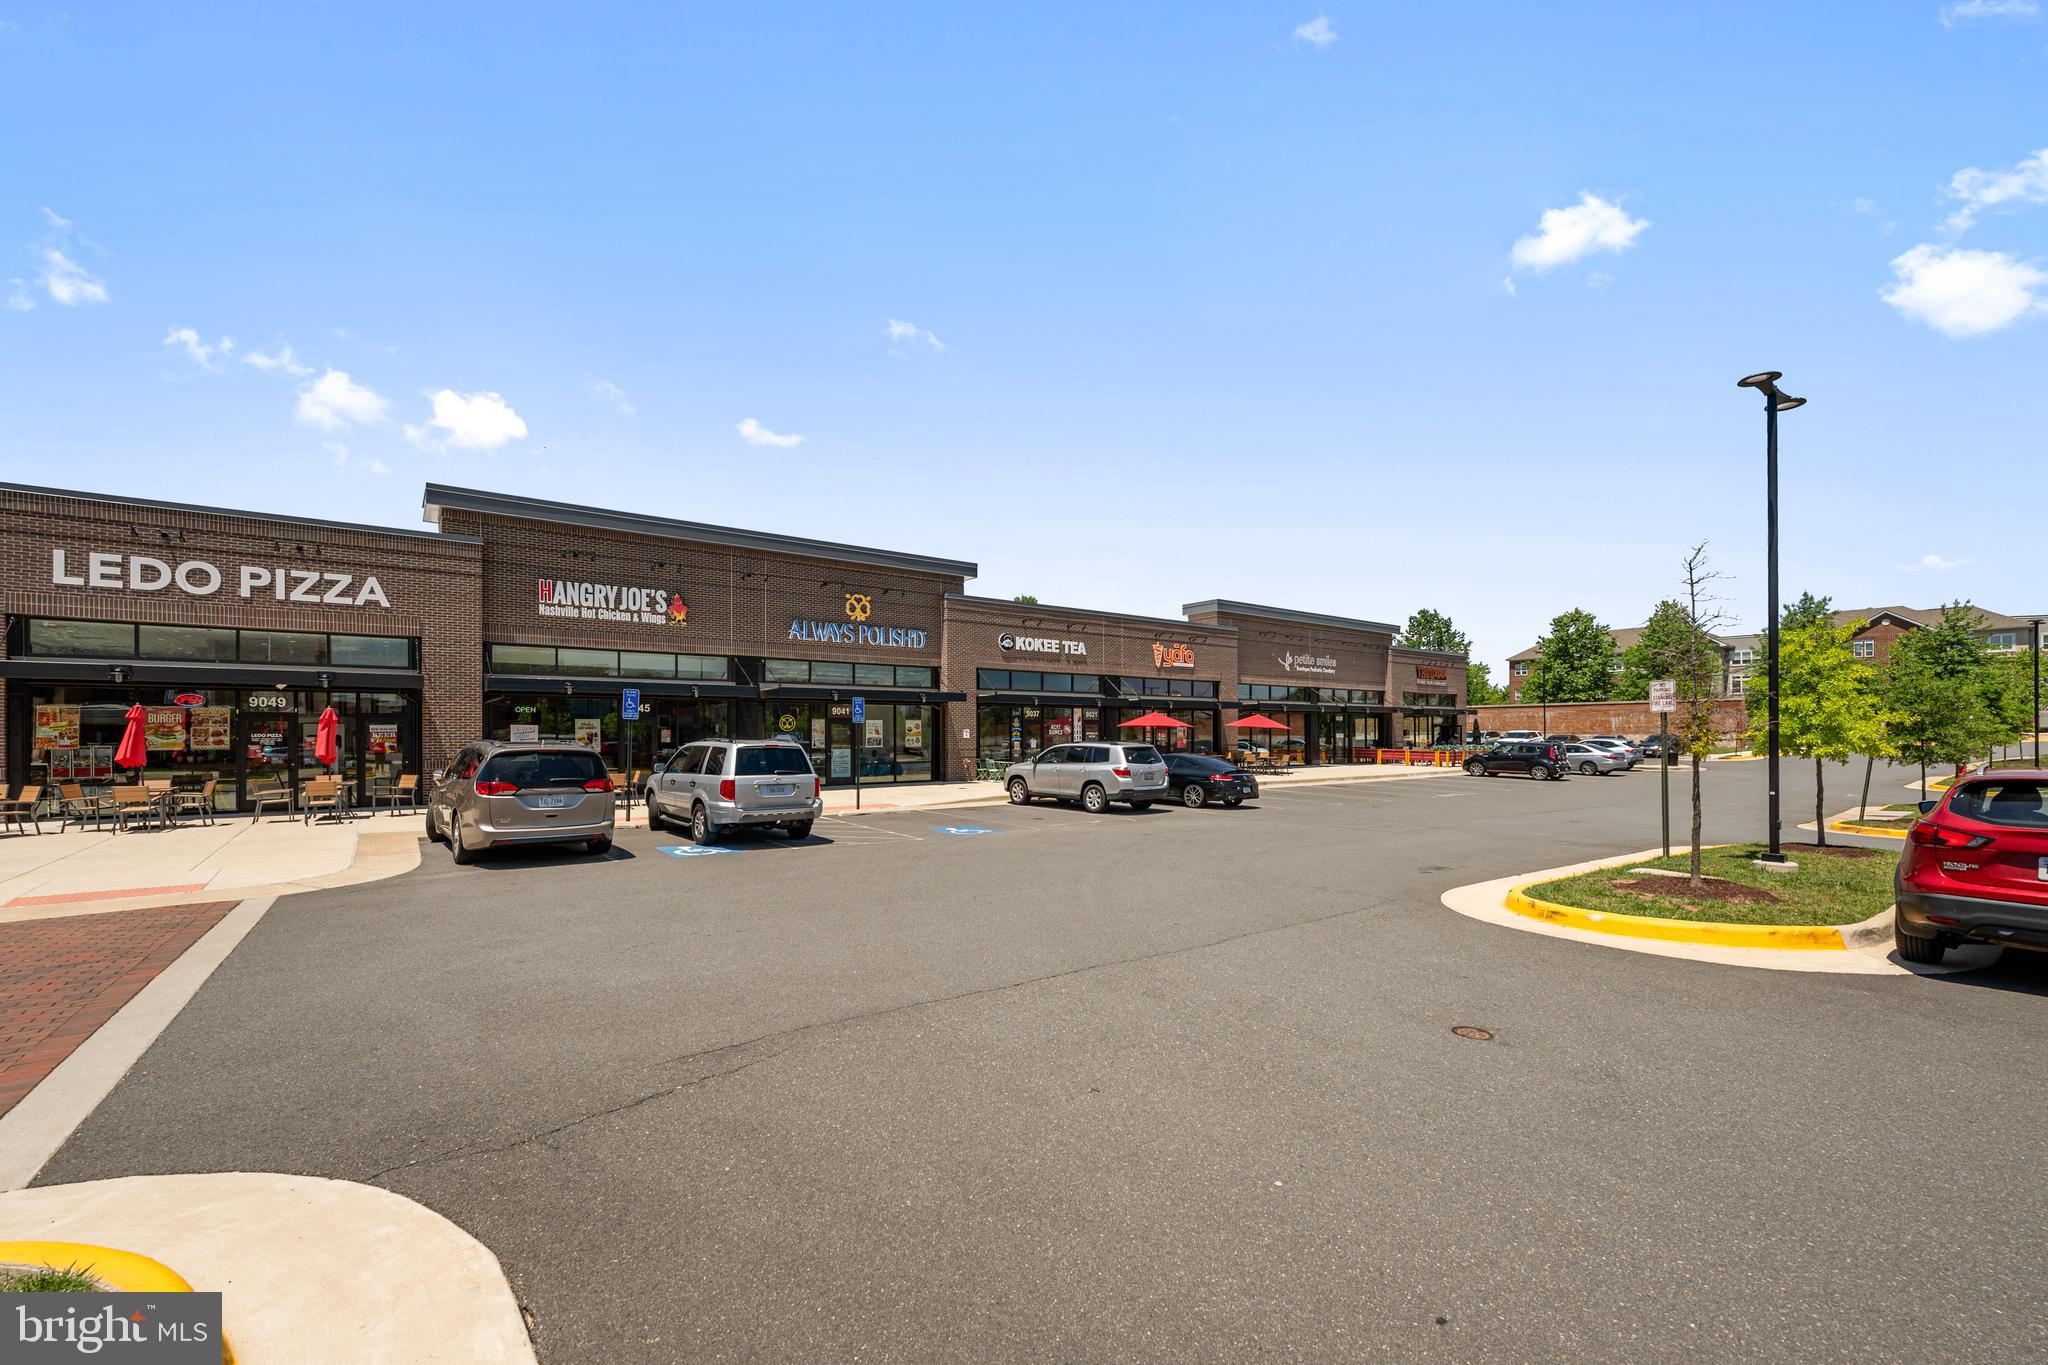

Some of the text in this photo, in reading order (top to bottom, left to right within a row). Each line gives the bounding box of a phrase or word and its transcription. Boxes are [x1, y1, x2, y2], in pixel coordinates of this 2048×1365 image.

[52, 549, 391, 608] LEDO PIZZA
[538, 579, 668, 613] HANGRY JOE'S
[539, 604, 667, 625] Nashville Hot Chicken & Wings
[788, 620, 856, 643] ALWAYS
[1015, 636, 1087, 655] KOKEE TEA
[1294, 653, 1337, 668] petite smiles
[175, 694, 204, 705] OPEN
[249, 696, 287, 708] 9049
[515, 706, 537, 714] OPEN
[832, 707, 850, 715] 9041
[1026, 710, 1040, 718] 9037
[148, 713, 182, 724] BURGER
